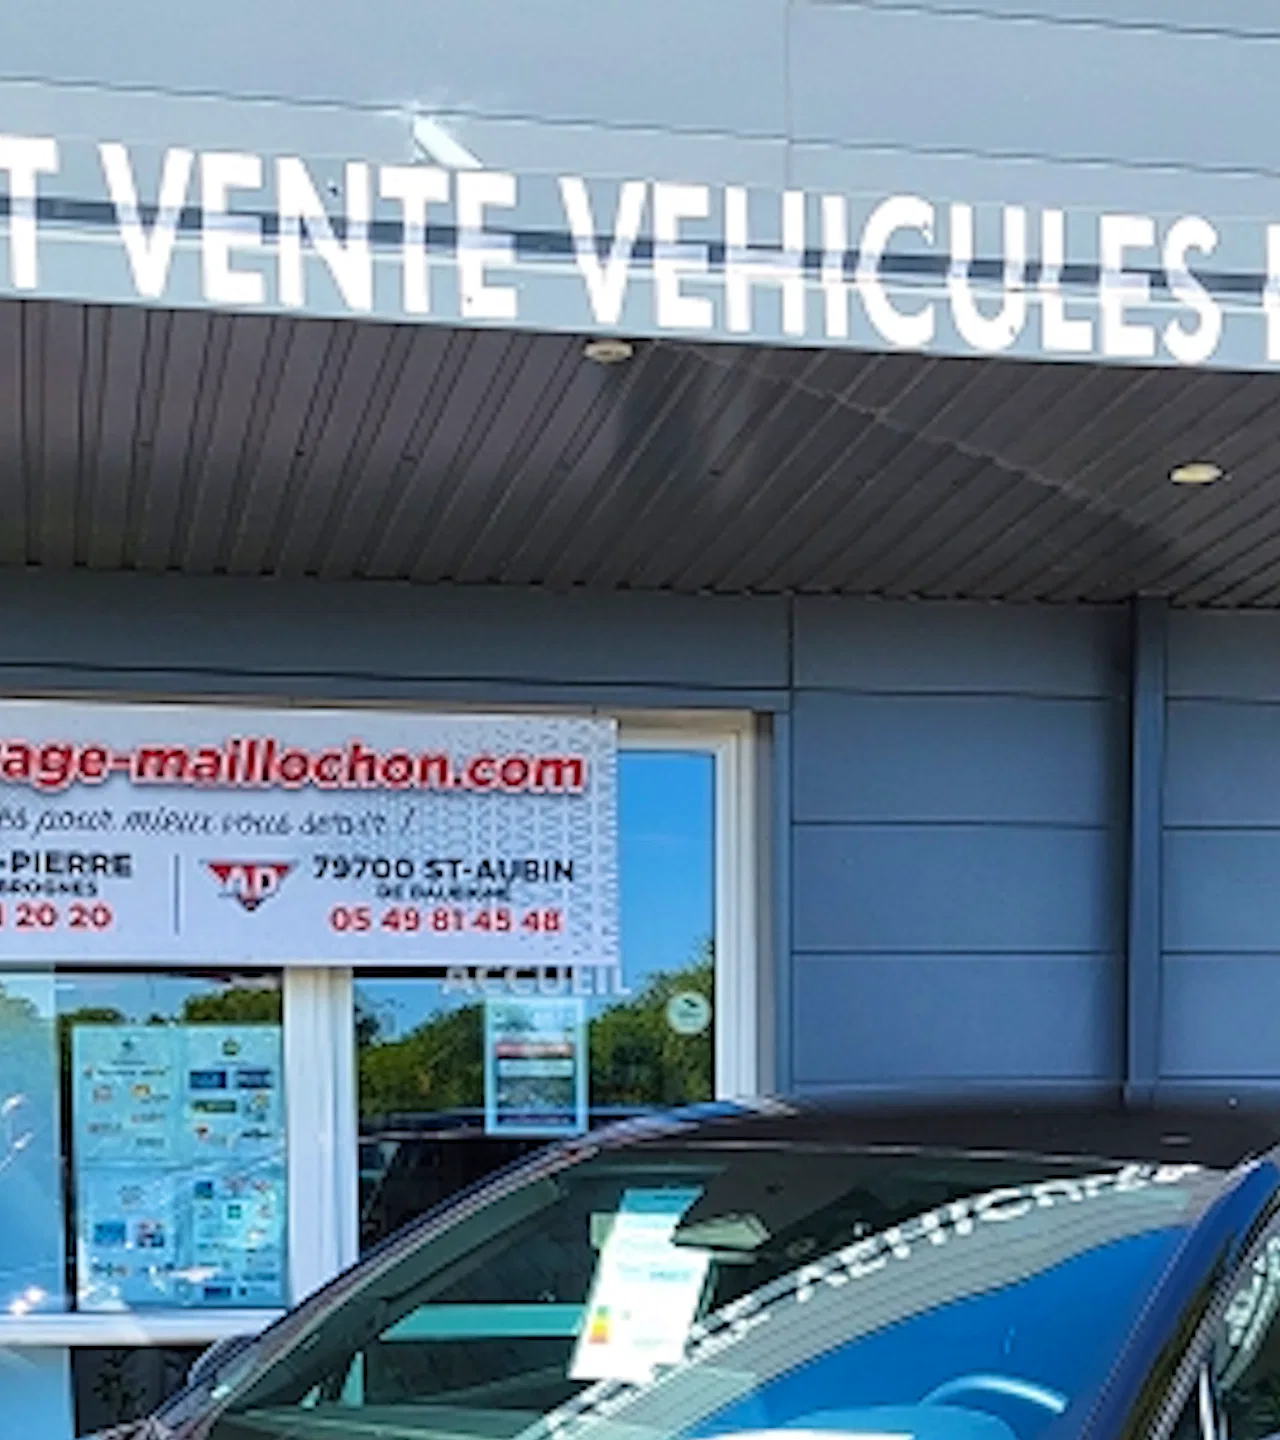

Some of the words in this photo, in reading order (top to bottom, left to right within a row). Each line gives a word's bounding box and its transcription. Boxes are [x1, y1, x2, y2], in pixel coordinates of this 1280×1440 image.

[99, 142, 518, 320] VENTE
[558, 176, 1223, 364] VEHICULES
[31, 806, 114, 840] pour
[222, 810, 293, 836] vous
[314, 855, 415, 880] 79700
[425, 857, 574, 884] ST-AUBIN
[17, 904, 58, 928] 20
[69, 905, 113, 929] 20
[331, 907, 371, 932] 05
[382, 907, 421, 932] 49
[431, 907, 464, 932] 81
[472, 907, 511, 932] 45
[520, 908, 563, 933] 48
[440, 965, 632, 996] ACCUEIL
